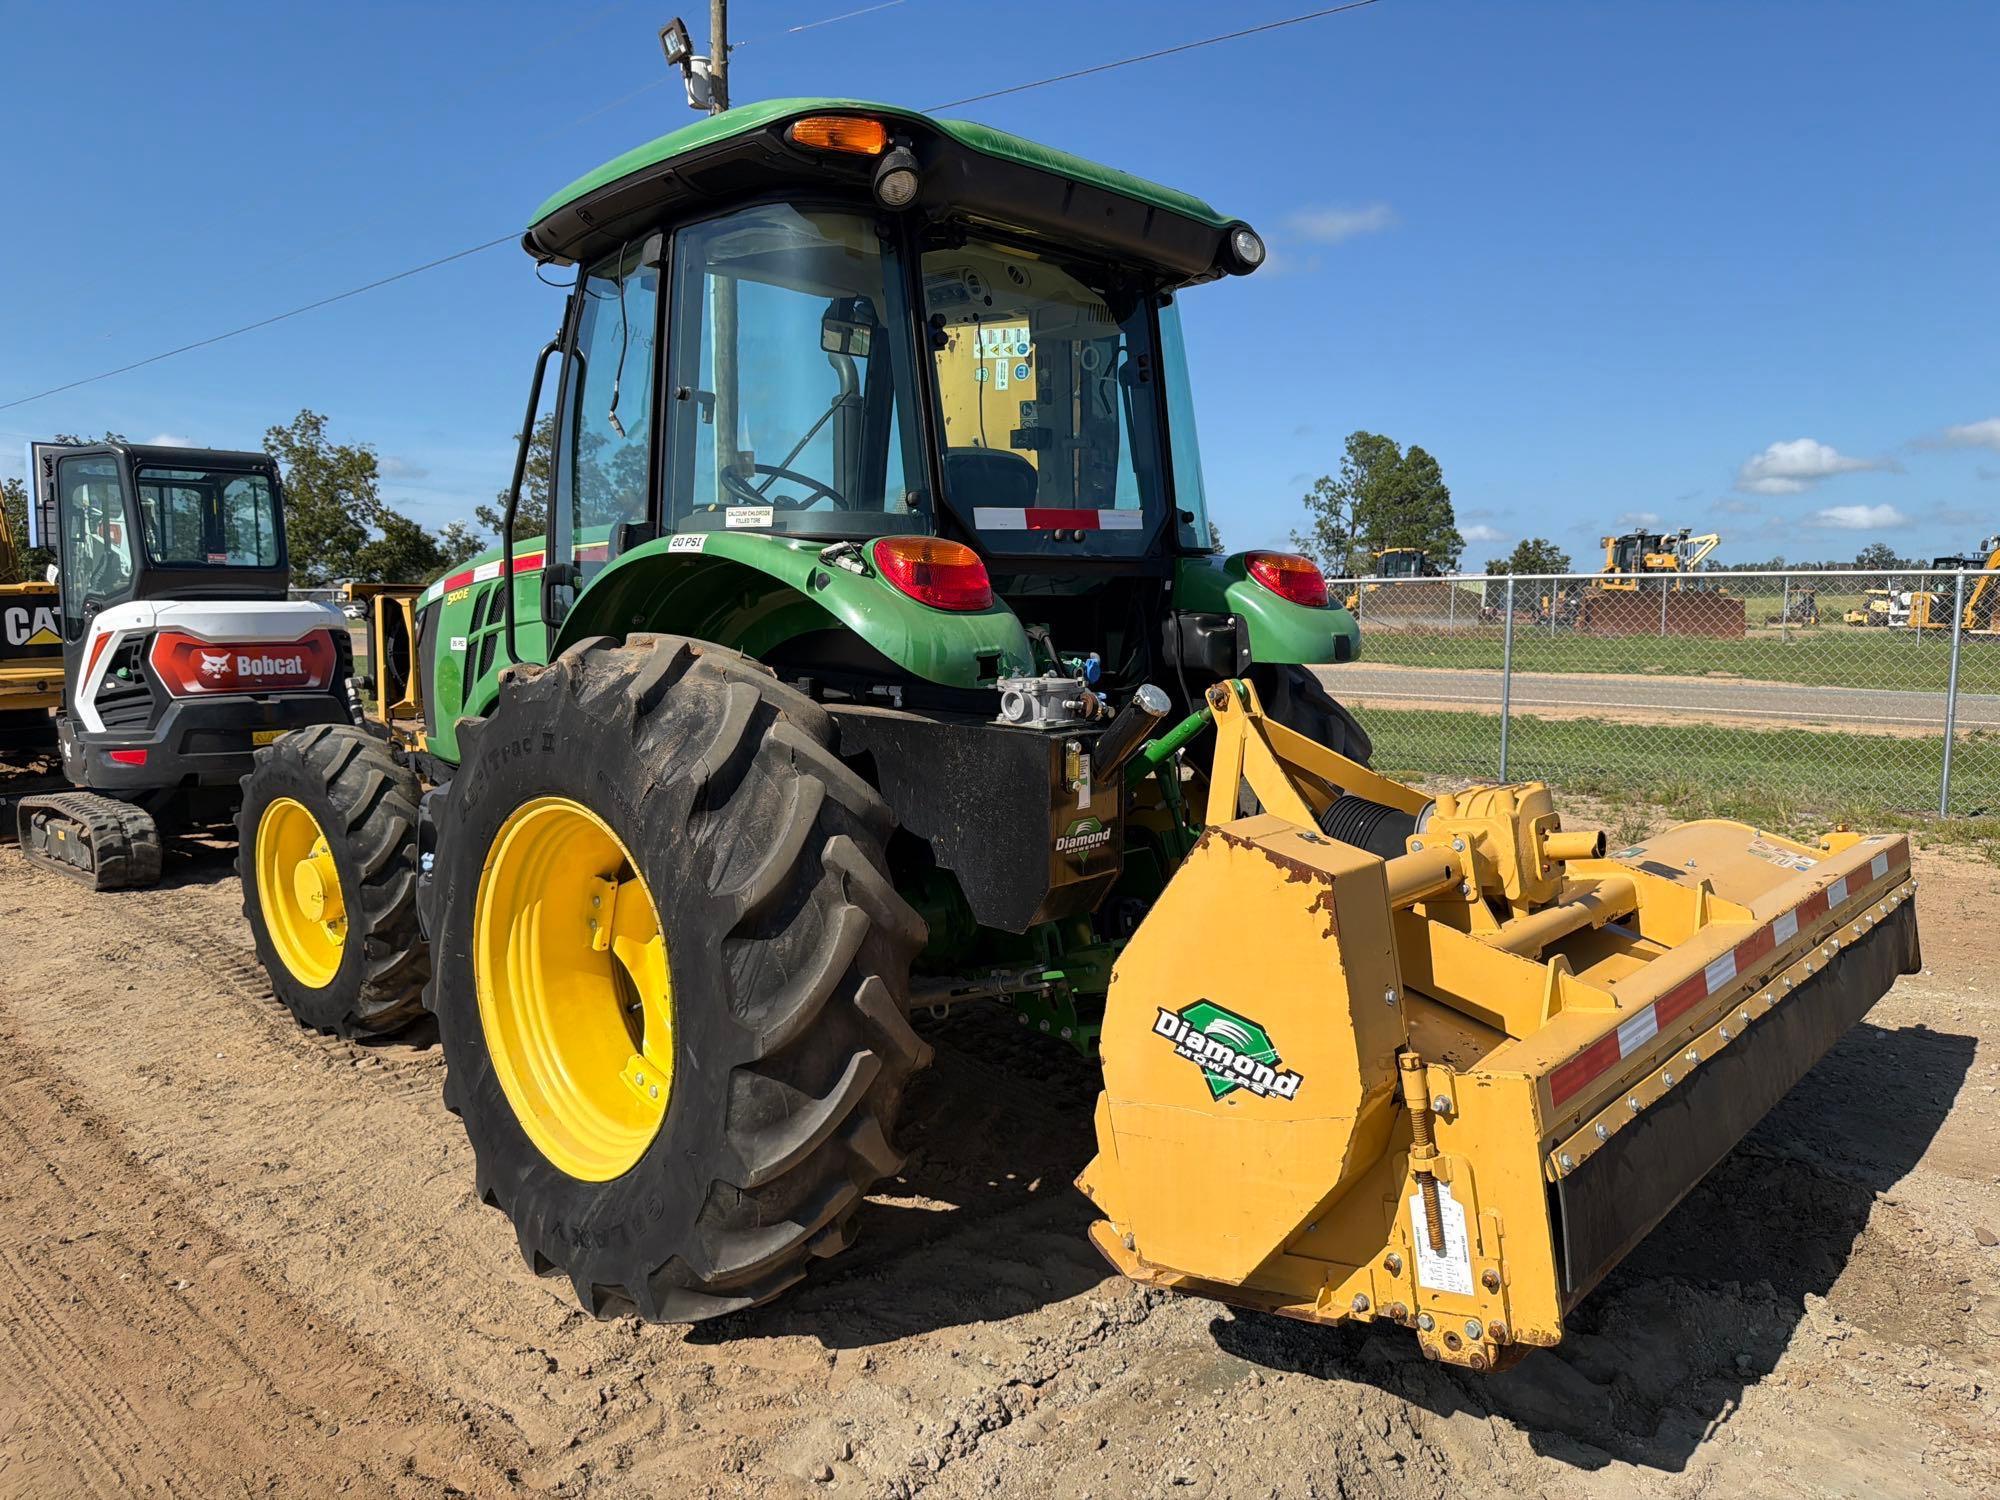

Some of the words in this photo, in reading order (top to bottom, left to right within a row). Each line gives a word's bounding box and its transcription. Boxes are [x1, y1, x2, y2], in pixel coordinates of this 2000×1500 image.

[727, 510, 748, 518] CALCIUM
[748, 509, 771, 517] CHLORIDE
[735, 517, 750, 525] FILLED
[672, 537, 685, 547] 20
[685, 537, 702, 547] PSI
[236, 655, 303, 676] Bobcat
[1055, 827, 1112, 852] Diamond
[1154, 1009, 1301, 1098] Diamond
